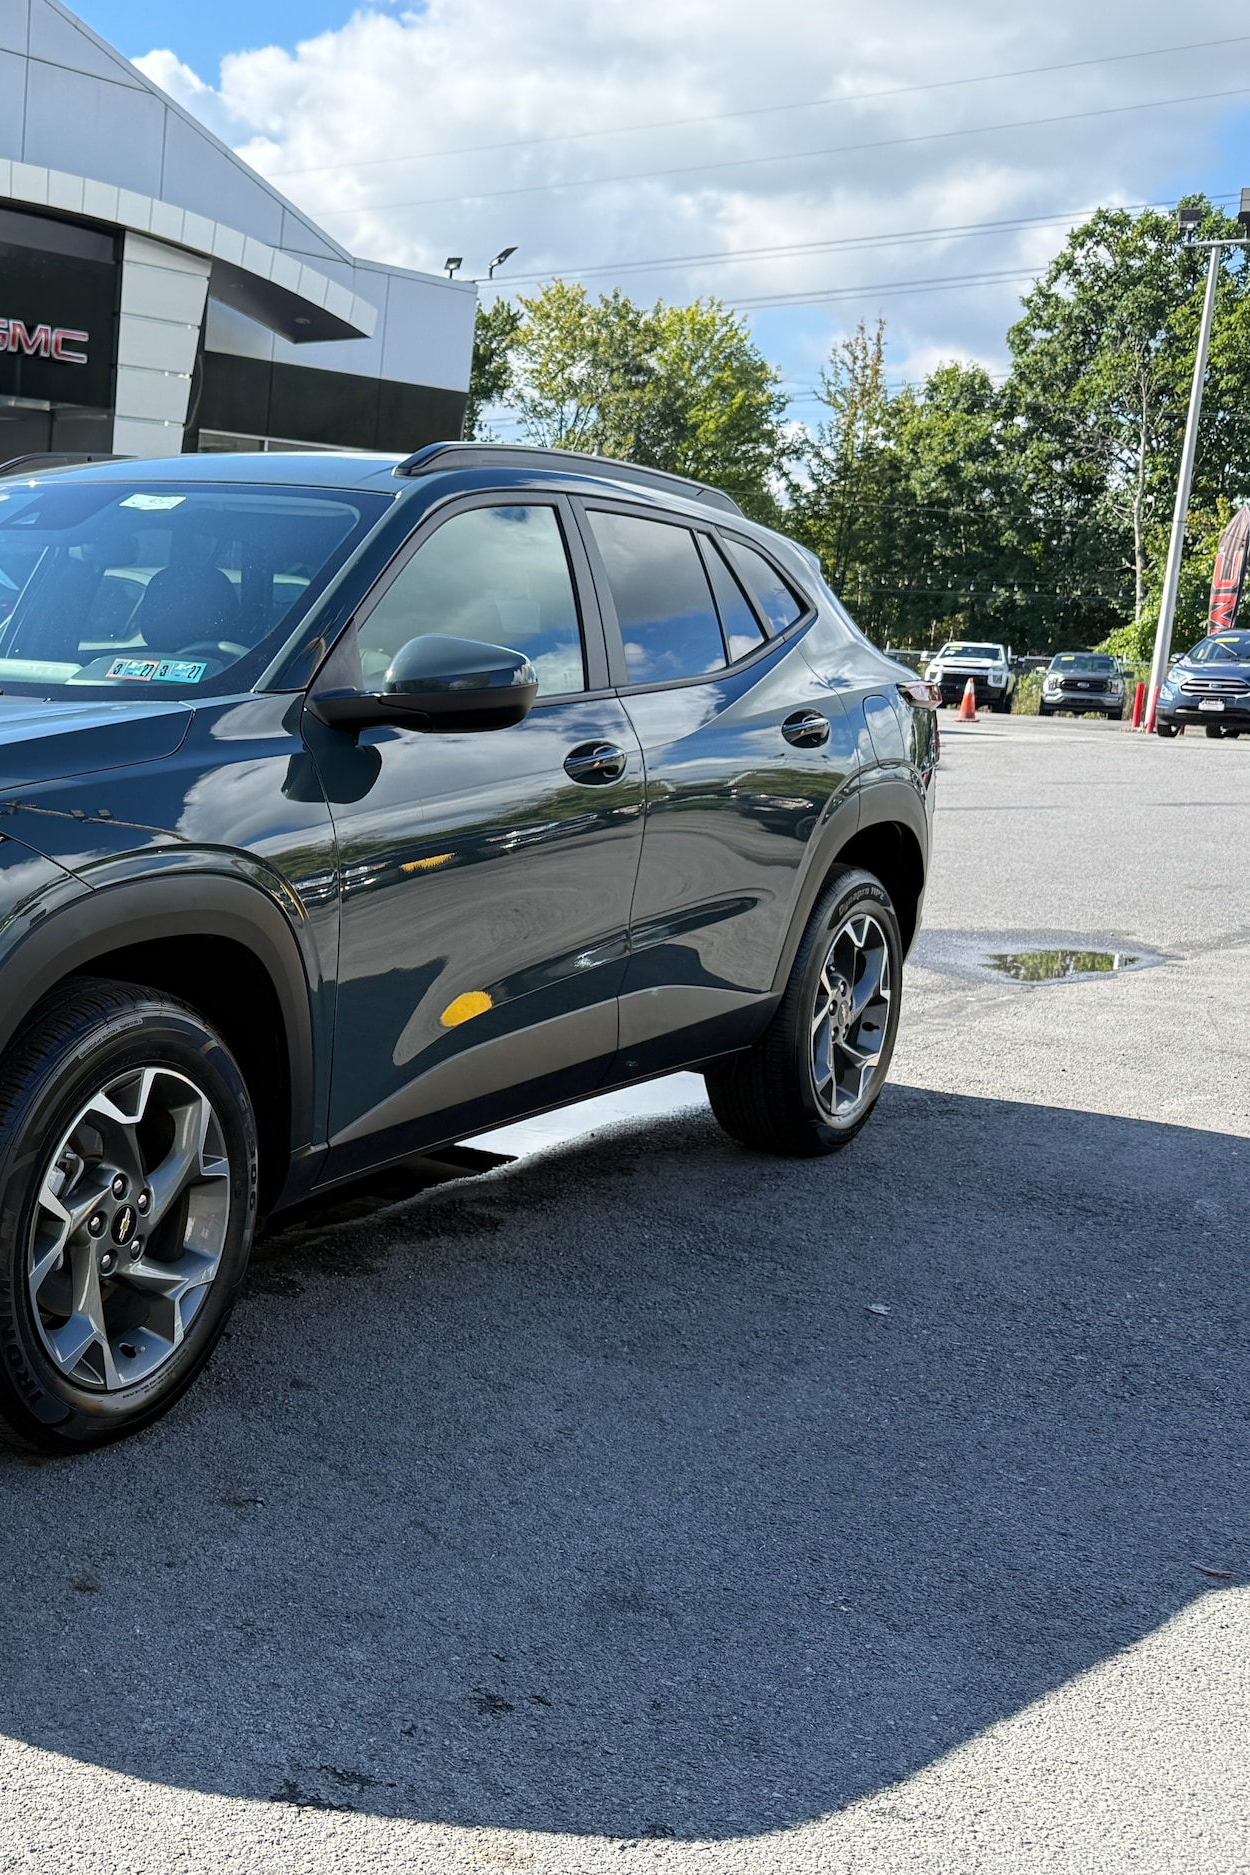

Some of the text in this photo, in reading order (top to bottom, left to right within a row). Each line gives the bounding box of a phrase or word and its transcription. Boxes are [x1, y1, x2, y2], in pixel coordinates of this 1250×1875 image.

[1209, 552, 1242, 634] MC
[113, 664, 155, 678] 3 27
[159, 665, 202, 680] 3 27
